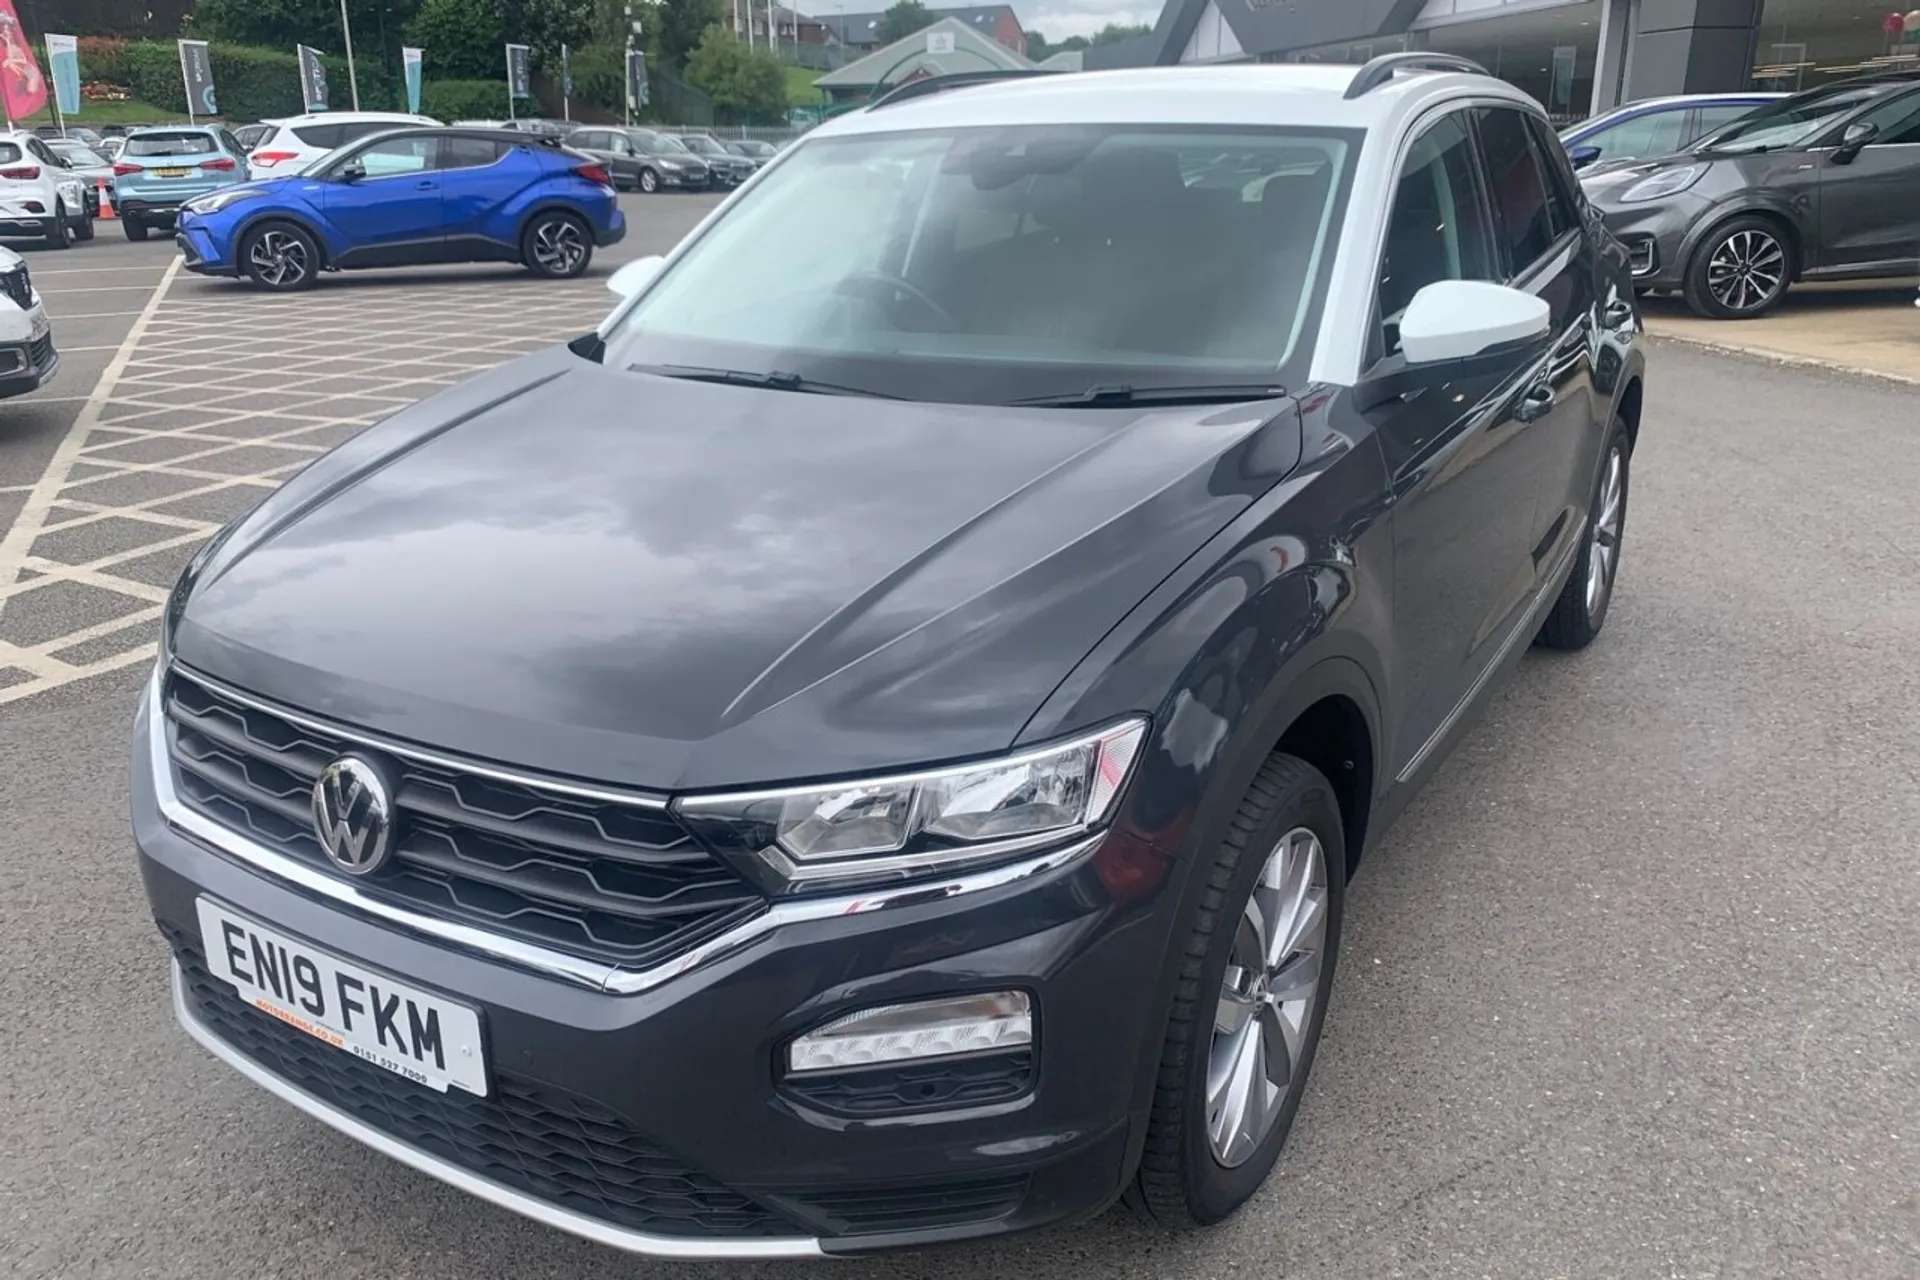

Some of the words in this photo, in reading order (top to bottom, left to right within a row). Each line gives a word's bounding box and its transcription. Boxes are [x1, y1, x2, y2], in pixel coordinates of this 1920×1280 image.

[221, 919, 325, 1017] EN19
[335, 972, 445, 1071] FKM
[353, 1045, 377, 1063] 0151
